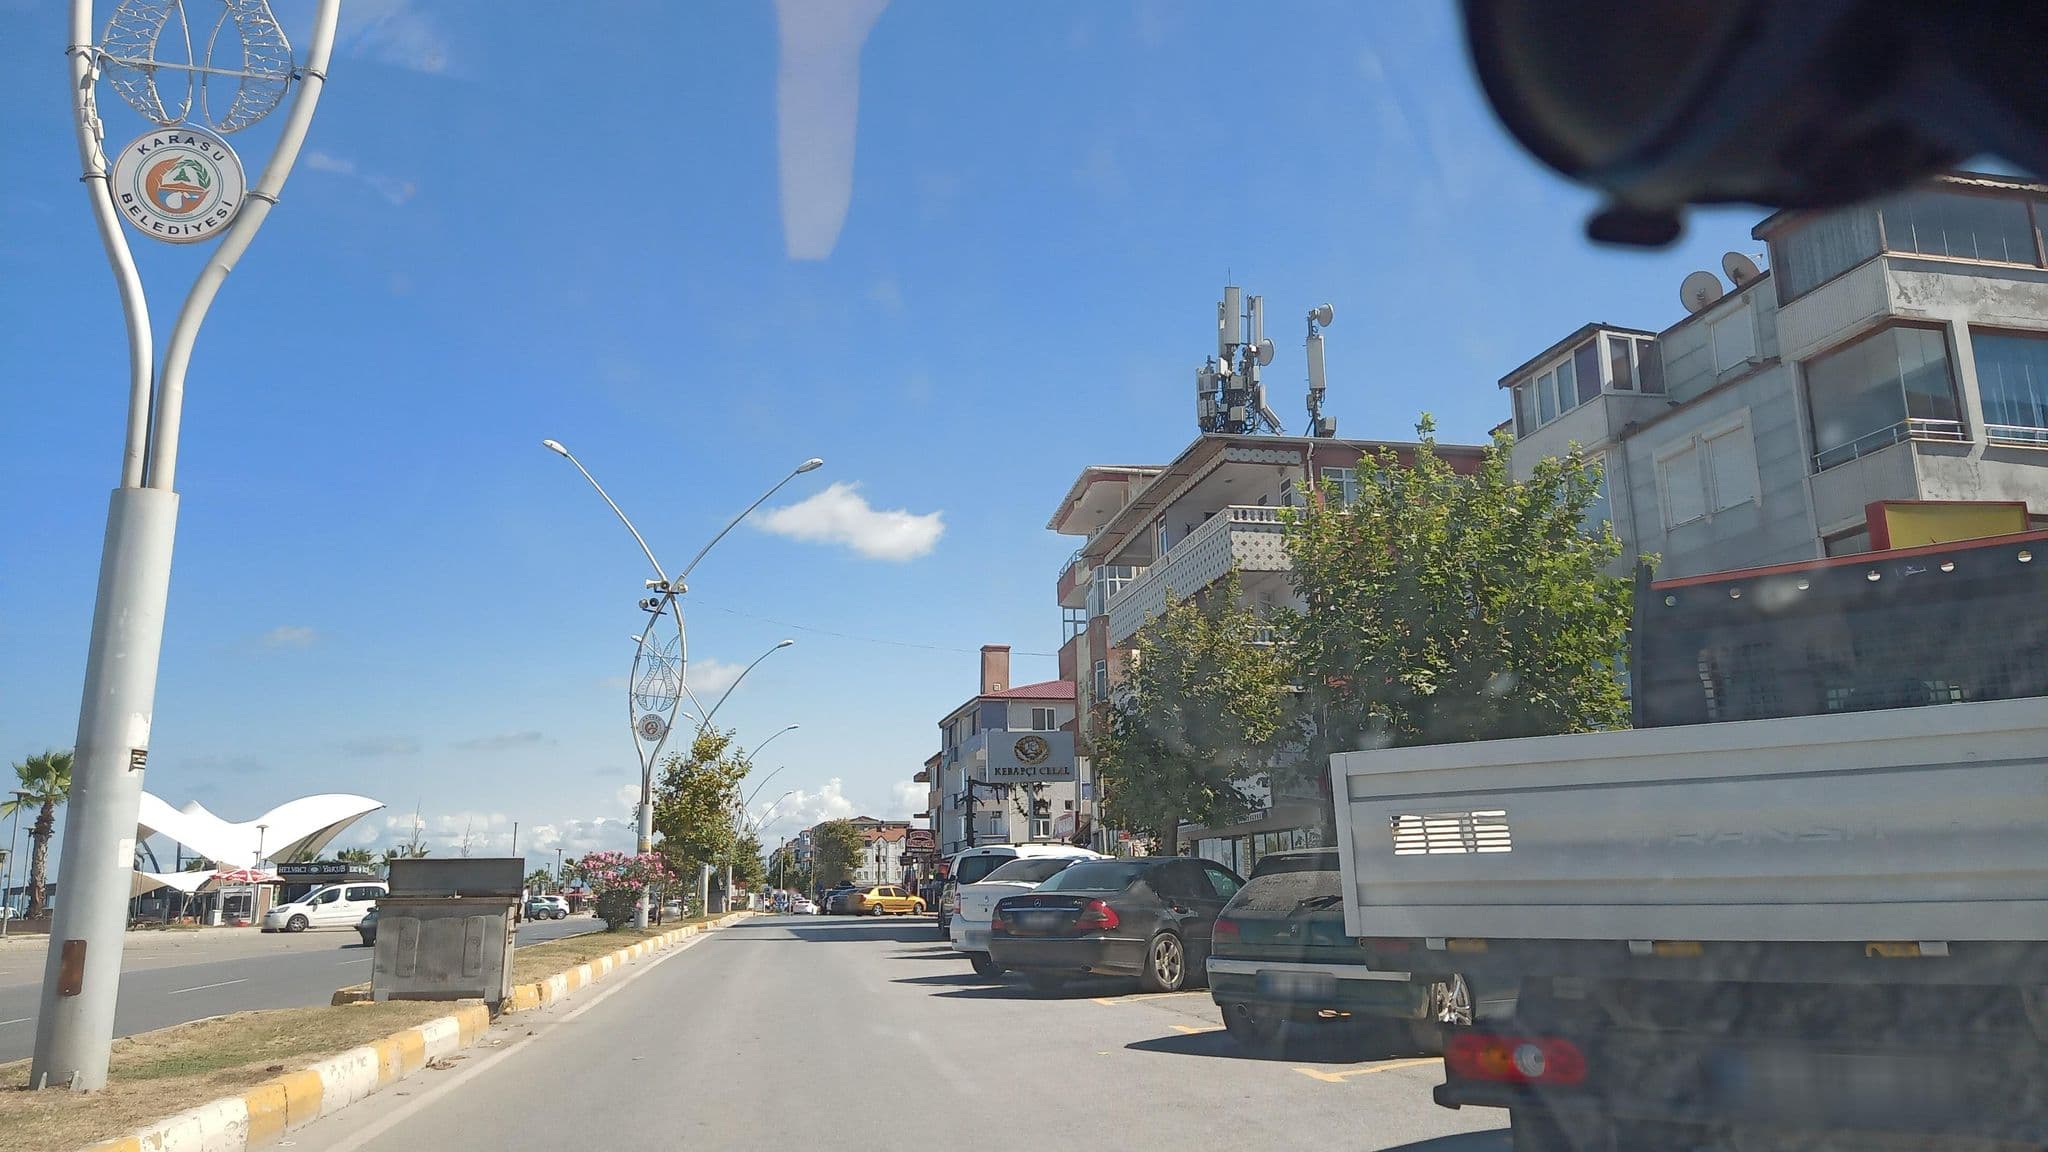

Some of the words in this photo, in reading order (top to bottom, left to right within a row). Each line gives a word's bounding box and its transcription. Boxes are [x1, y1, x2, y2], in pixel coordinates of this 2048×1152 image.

[137, 135, 225, 162] KARASU
[121, 192, 233, 235] BELEDİYESİ
[994, 767, 1036, 777] KEBAPÇI
